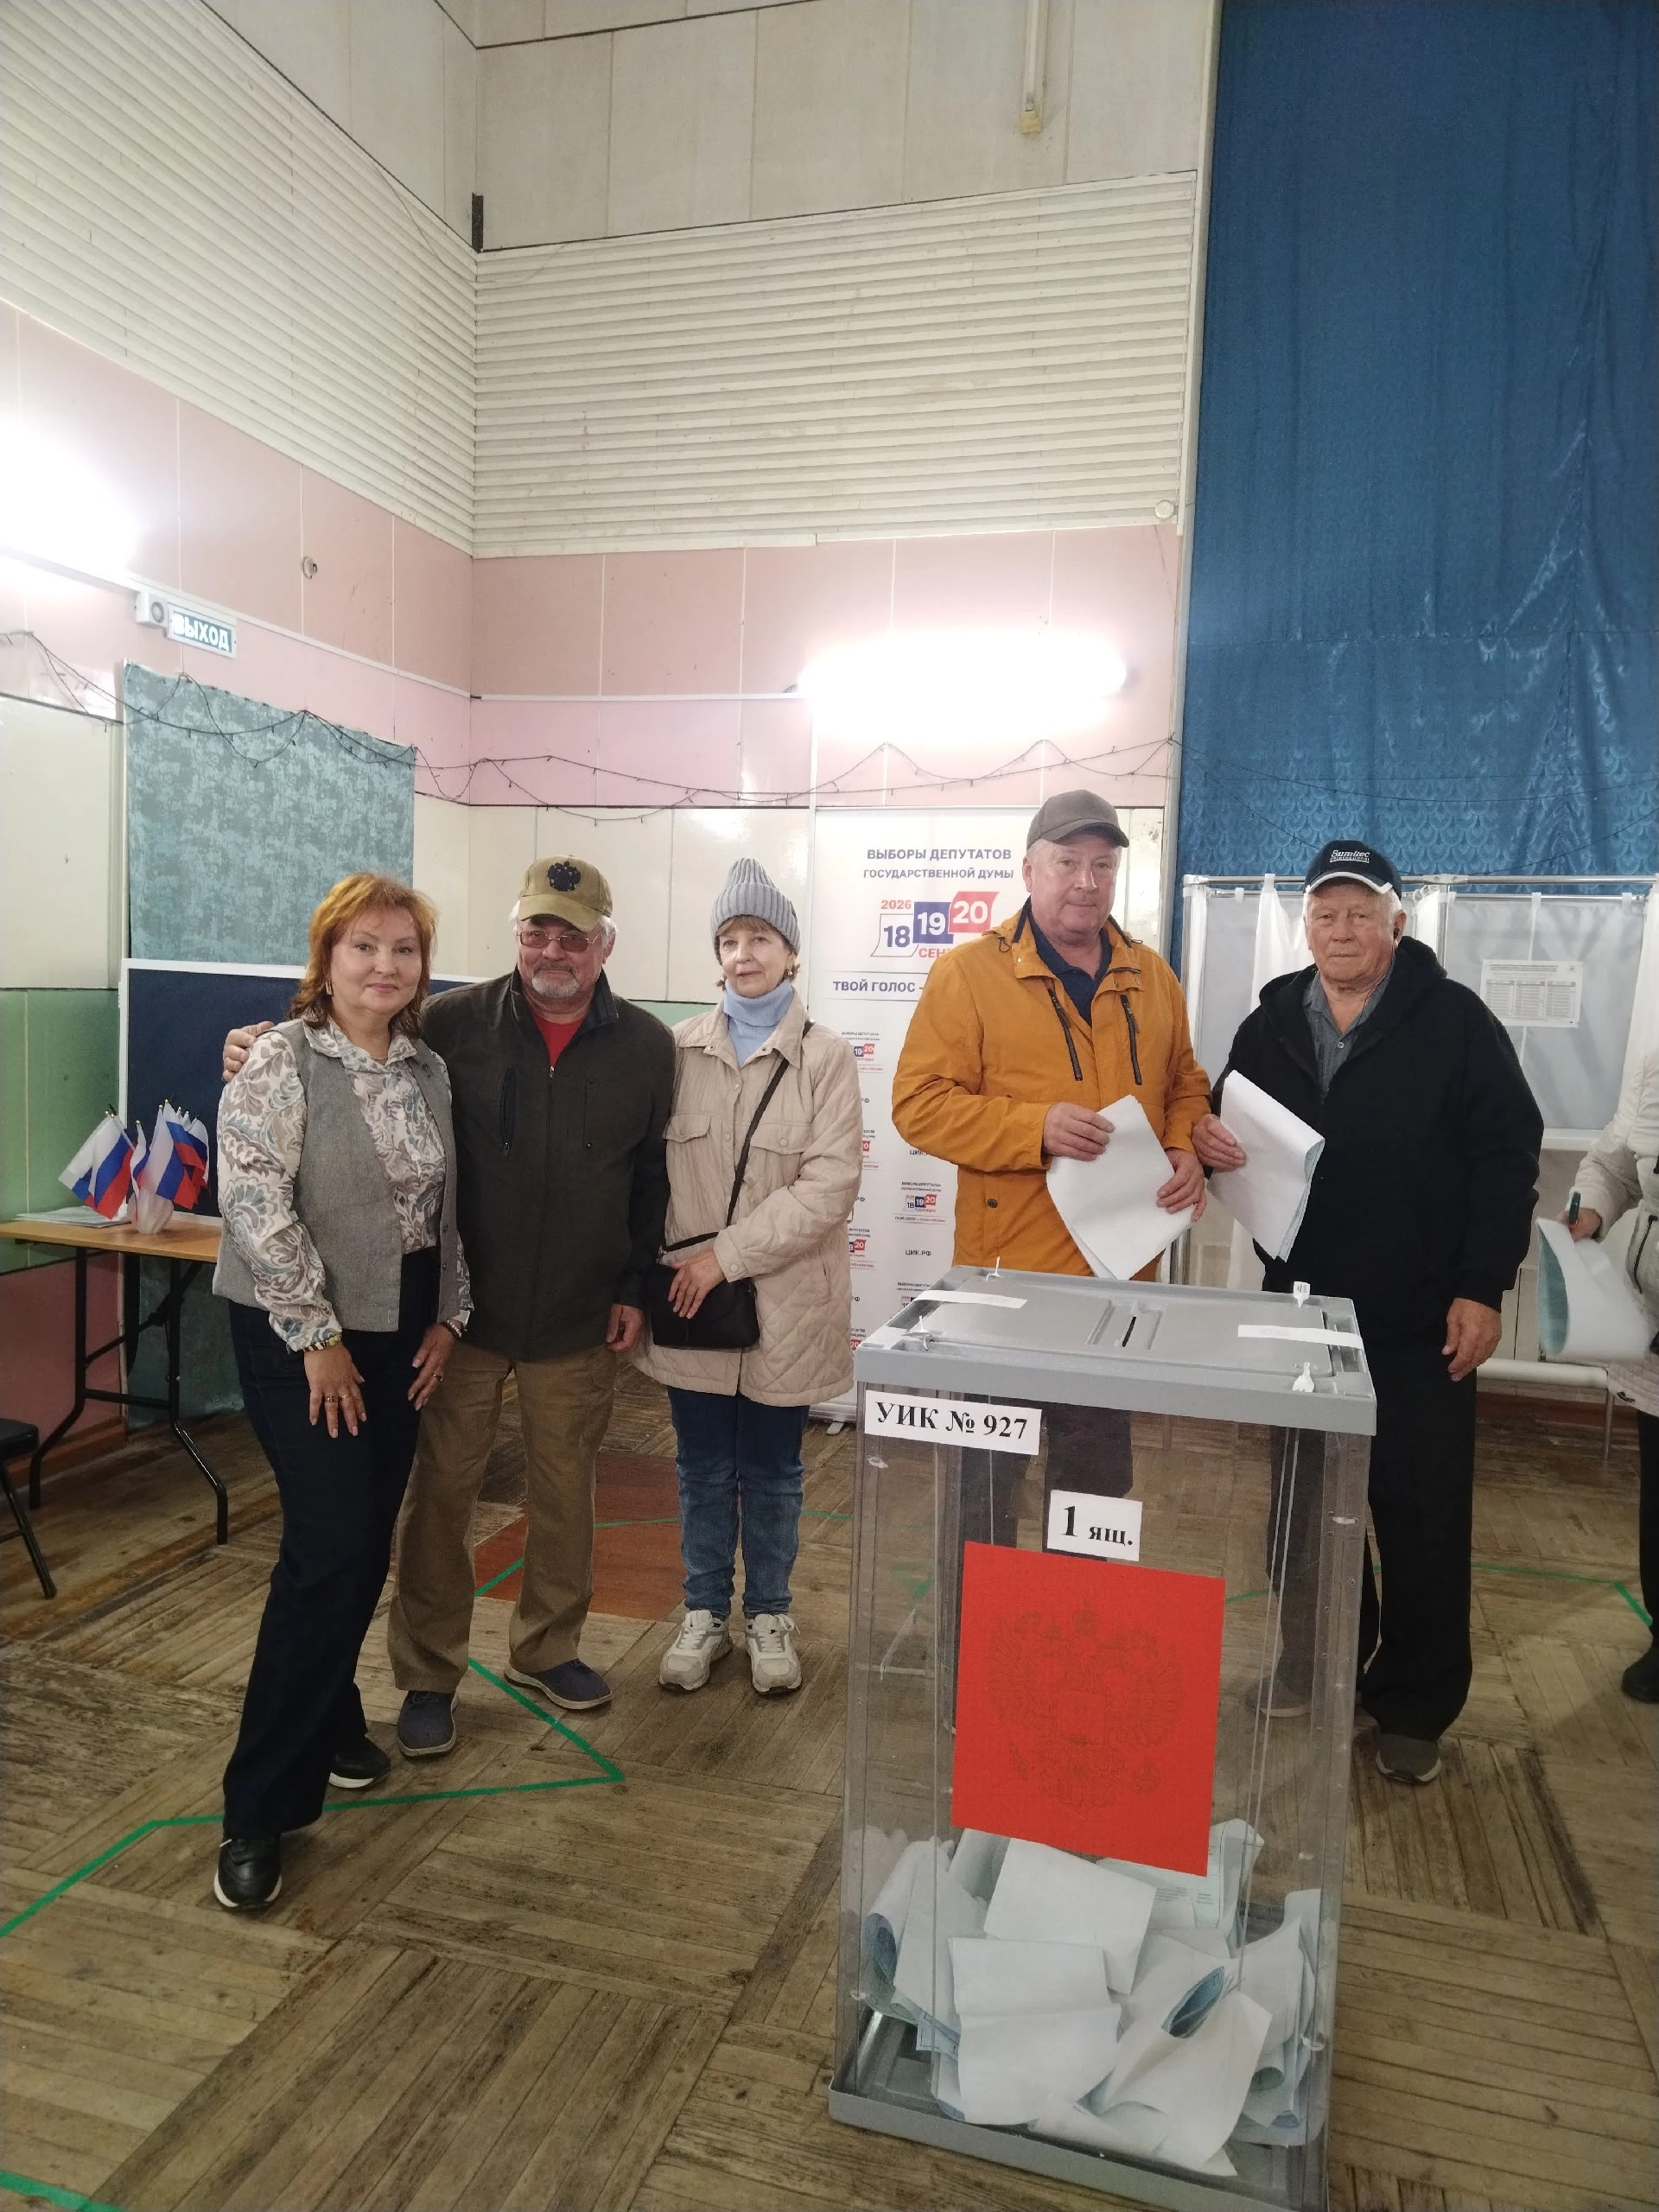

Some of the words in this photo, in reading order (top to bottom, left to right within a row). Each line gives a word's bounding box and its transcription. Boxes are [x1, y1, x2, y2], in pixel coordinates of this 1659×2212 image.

[172, 613, 230, 652] ВЫХОД
[867, 849, 926, 860] ВЫБОРЫ
[930, 849, 1012, 861] ДЕПУТАТОВ
[863, 868, 976, 879] ГОСУДАРСТВЕННОЙ
[977, 869, 1014, 880] ДУМЫ
[880, 899, 912, 910] 2026
[883, 925, 911, 948] 18
[917, 912, 946, 936] 19
[952, 900, 988, 925] 20
[832, 978, 868, 992] ТВОЙ
[871, 982, 916, 993] ГОЛОС
[854, 1047, 862, 1056] 19
[874, 1401, 939, 1430] УИК
[944, 1410, 976, 1433] №
[982, 1414, 1028, 1440] 927
[1061, 1505, 1078, 1537] 1
[1088, 1526, 1134, 1547] ящ.
